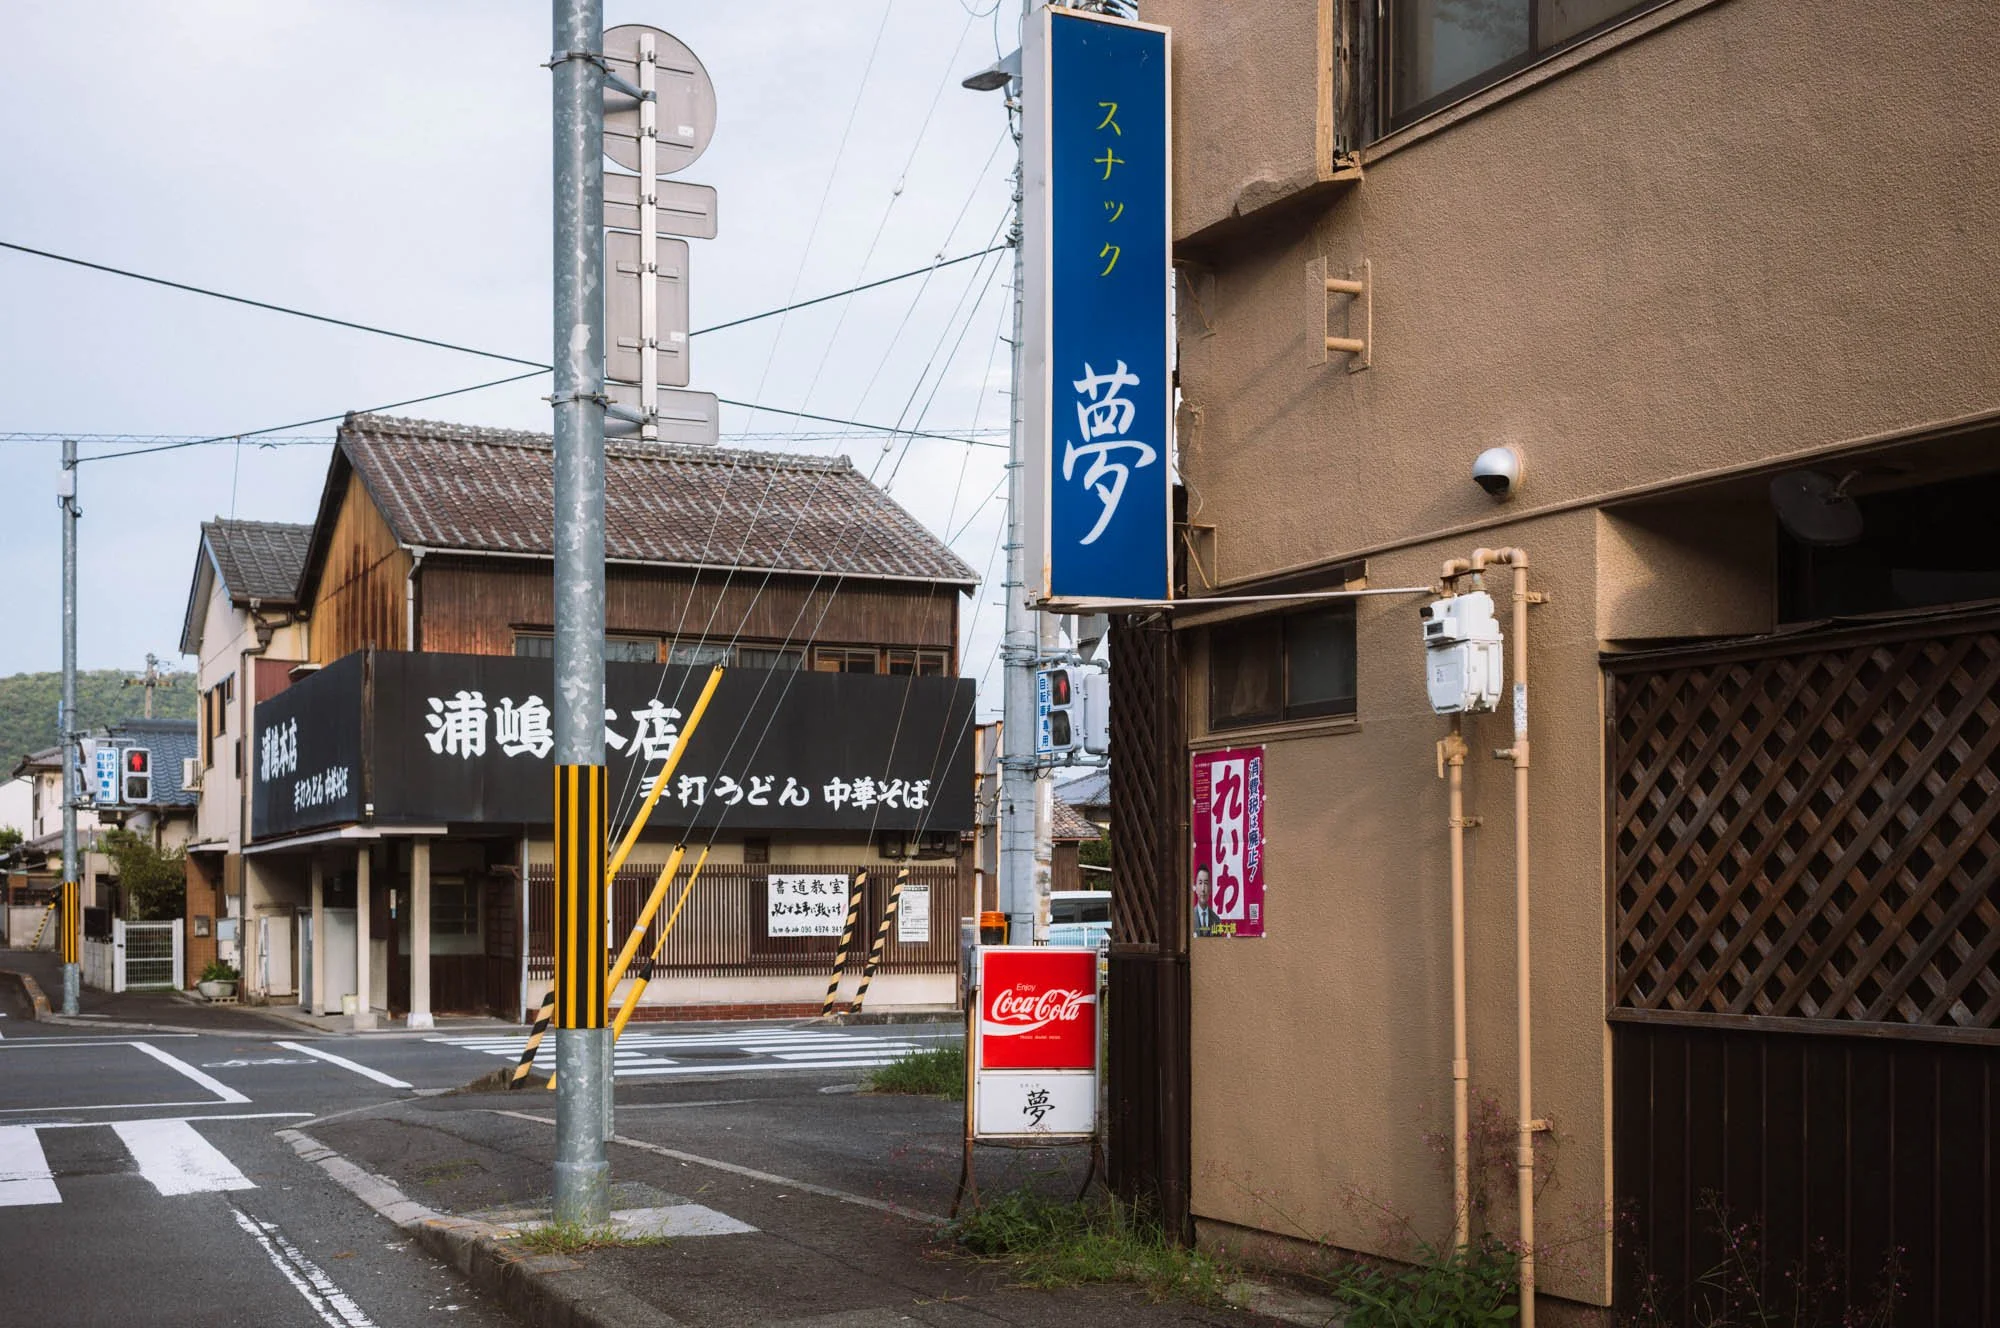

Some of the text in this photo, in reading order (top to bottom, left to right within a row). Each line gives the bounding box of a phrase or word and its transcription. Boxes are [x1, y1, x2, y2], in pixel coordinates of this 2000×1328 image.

[1095, 100, 1125, 278] スナック
[1063, 359, 1157, 546] 夢
[639, 774, 931, 811] 手打うどん 中華そば
[1212, 764, 1242, 915] れいわ
[771, 878, 845, 896] 書道教室
[991, 988, 1082, 1022] Coca-Cola
[1016, 983, 1037, 993] Enjoy
[1023, 1089, 1055, 1127] 夢
